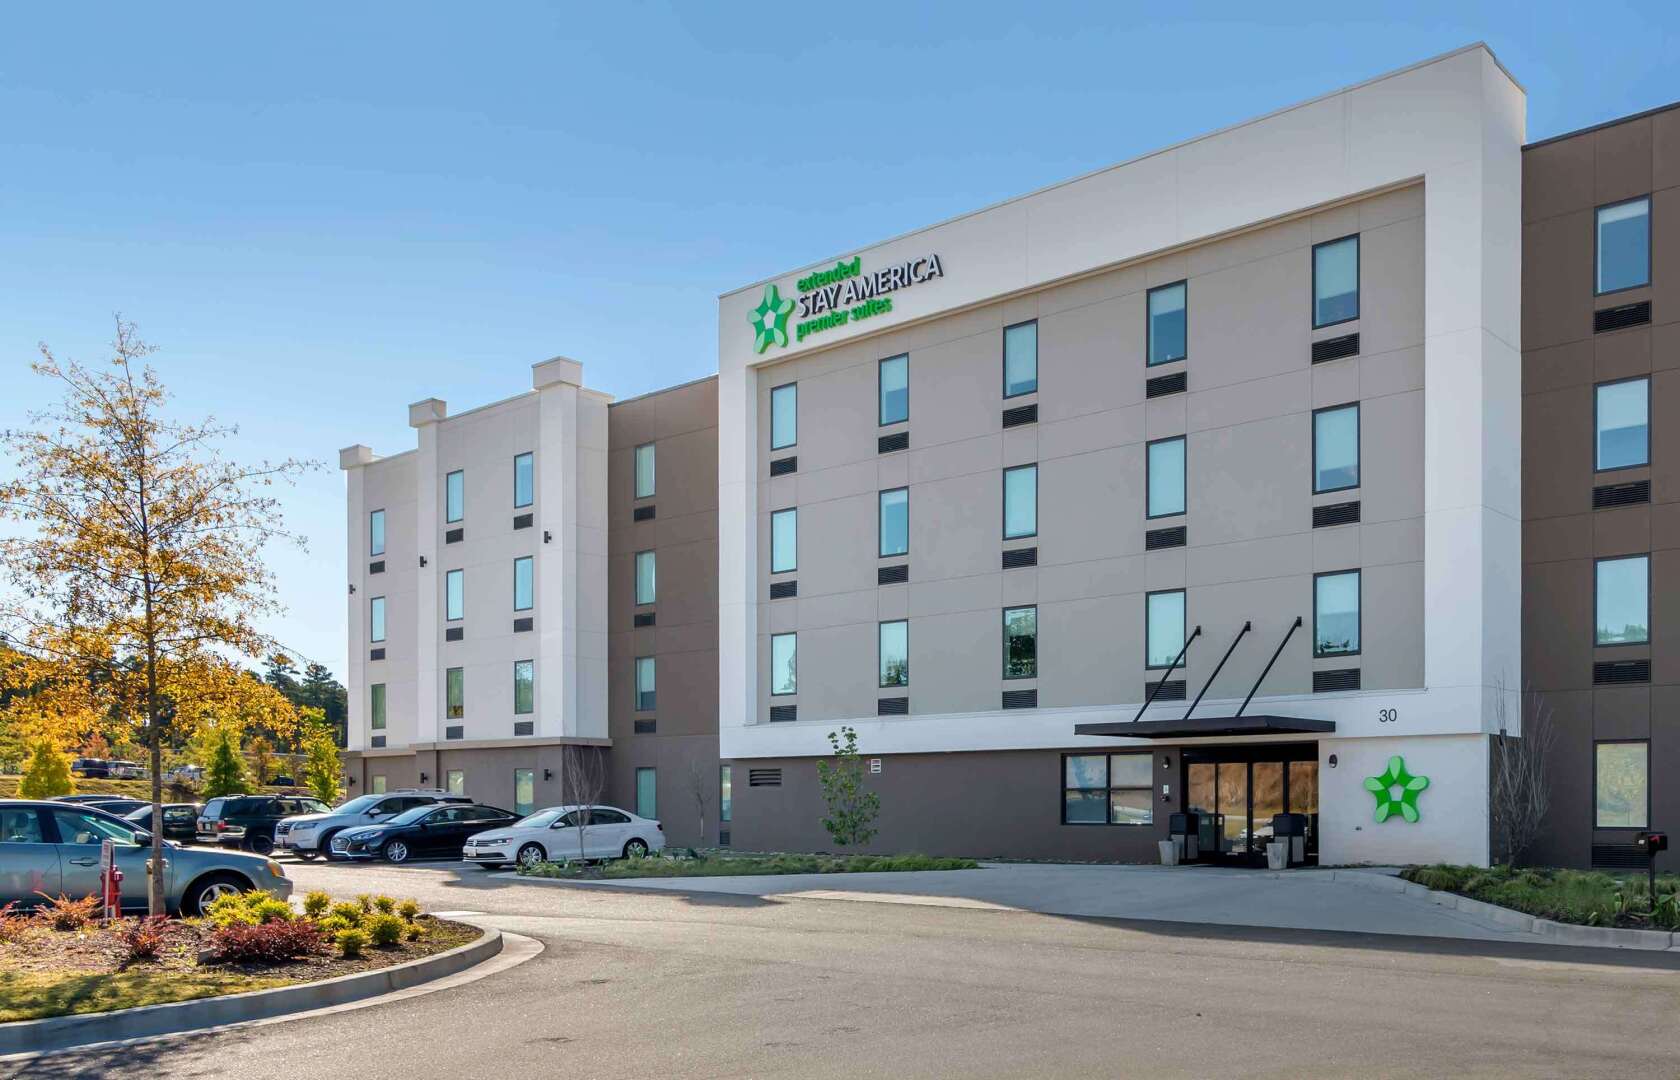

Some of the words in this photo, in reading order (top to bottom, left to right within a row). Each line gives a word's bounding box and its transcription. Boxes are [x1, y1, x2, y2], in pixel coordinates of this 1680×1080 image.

[797, 256, 861, 291] extended
[799, 284, 842, 318] STAY
[843, 254, 944, 304] AMERICA
[796, 310, 849, 342] premier
[850, 298, 893, 321] suites
[1379, 708, 1397, 722] 30
